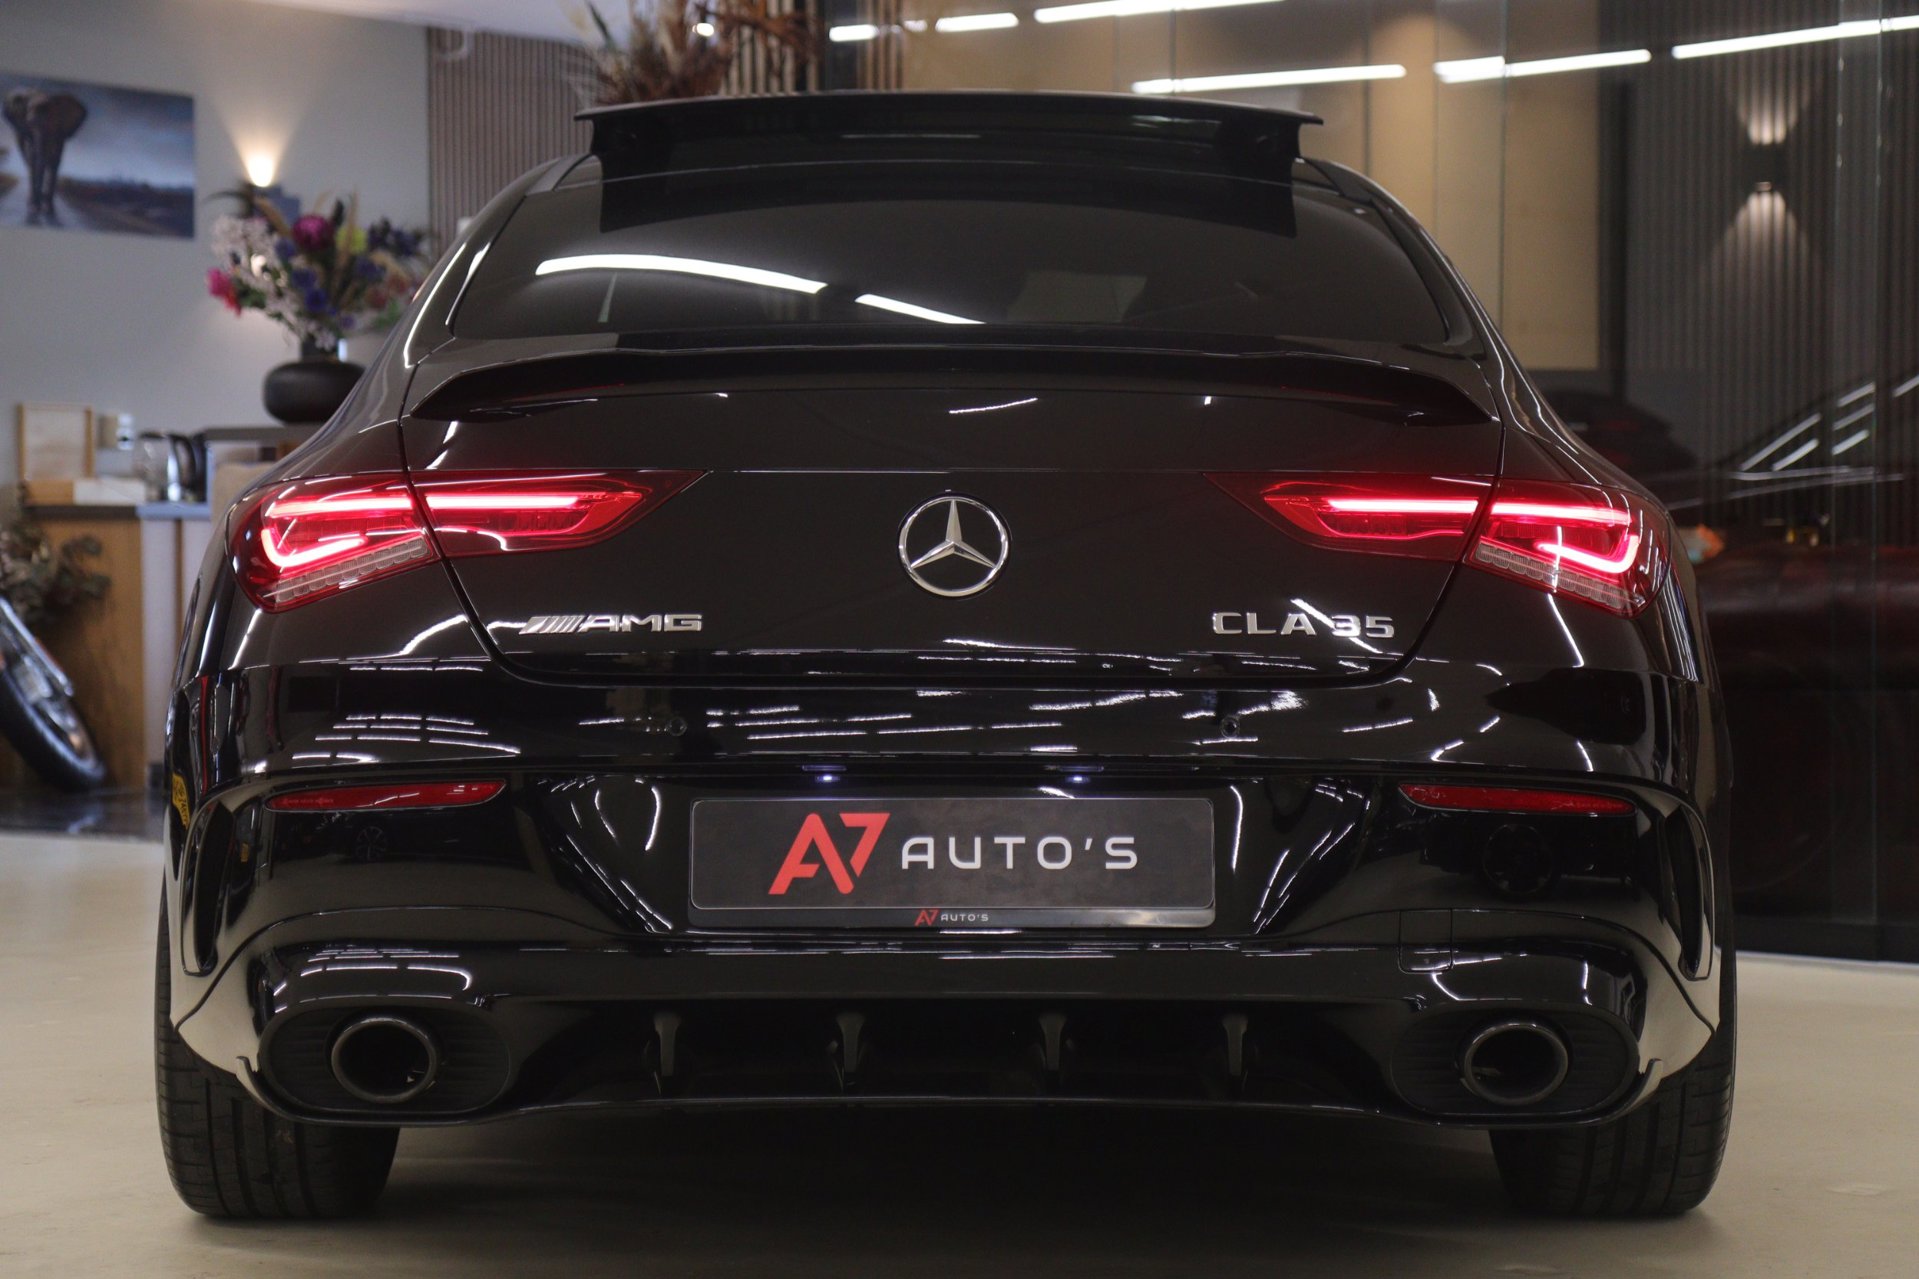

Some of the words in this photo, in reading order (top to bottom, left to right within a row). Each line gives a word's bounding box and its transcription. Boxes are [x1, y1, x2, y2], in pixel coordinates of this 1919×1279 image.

[577, 614, 702, 633] AMG
[1212, 612, 1317, 635] CLA
[1332, 615, 1395, 638] 35
[768, 812, 890, 895] A7
[901, 836, 1138, 870] AUTO'S
[940, 913, 989, 922] AUTO'S
